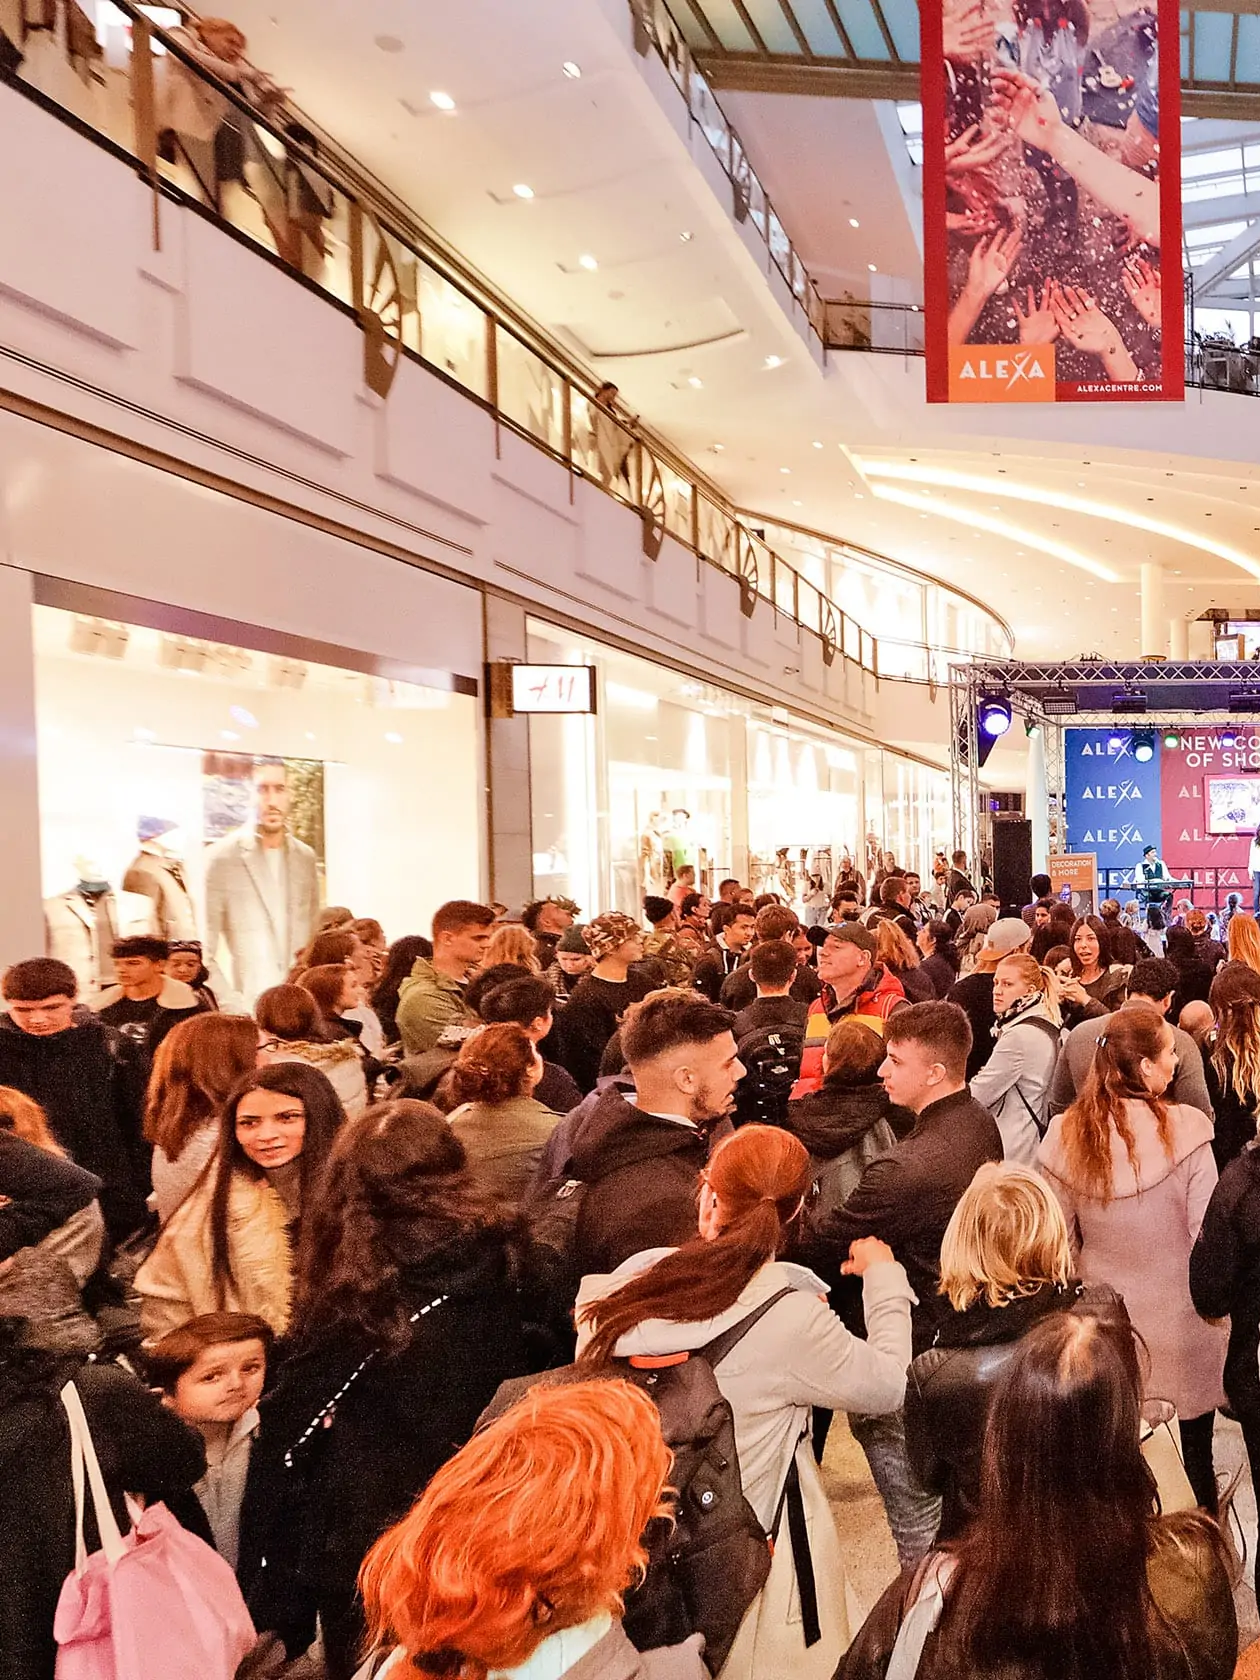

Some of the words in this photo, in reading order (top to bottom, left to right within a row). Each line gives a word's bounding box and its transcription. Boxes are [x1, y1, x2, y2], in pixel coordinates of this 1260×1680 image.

[959, 351, 1046, 390] ALEXA
[1077, 384, 1162, 393] ALEXACENTRE.COM
[1081, 735, 1134, 765] ALEX
[1180, 736, 1223, 751] NEW
[1186, 753, 1213, 768] OF
[1082, 779, 1143, 808] ALEXA
[1082, 822, 1143, 851] ALEXA
[1051, 860, 1091, 868] DECORATION
[1058, 868, 1079, 876] MORE
